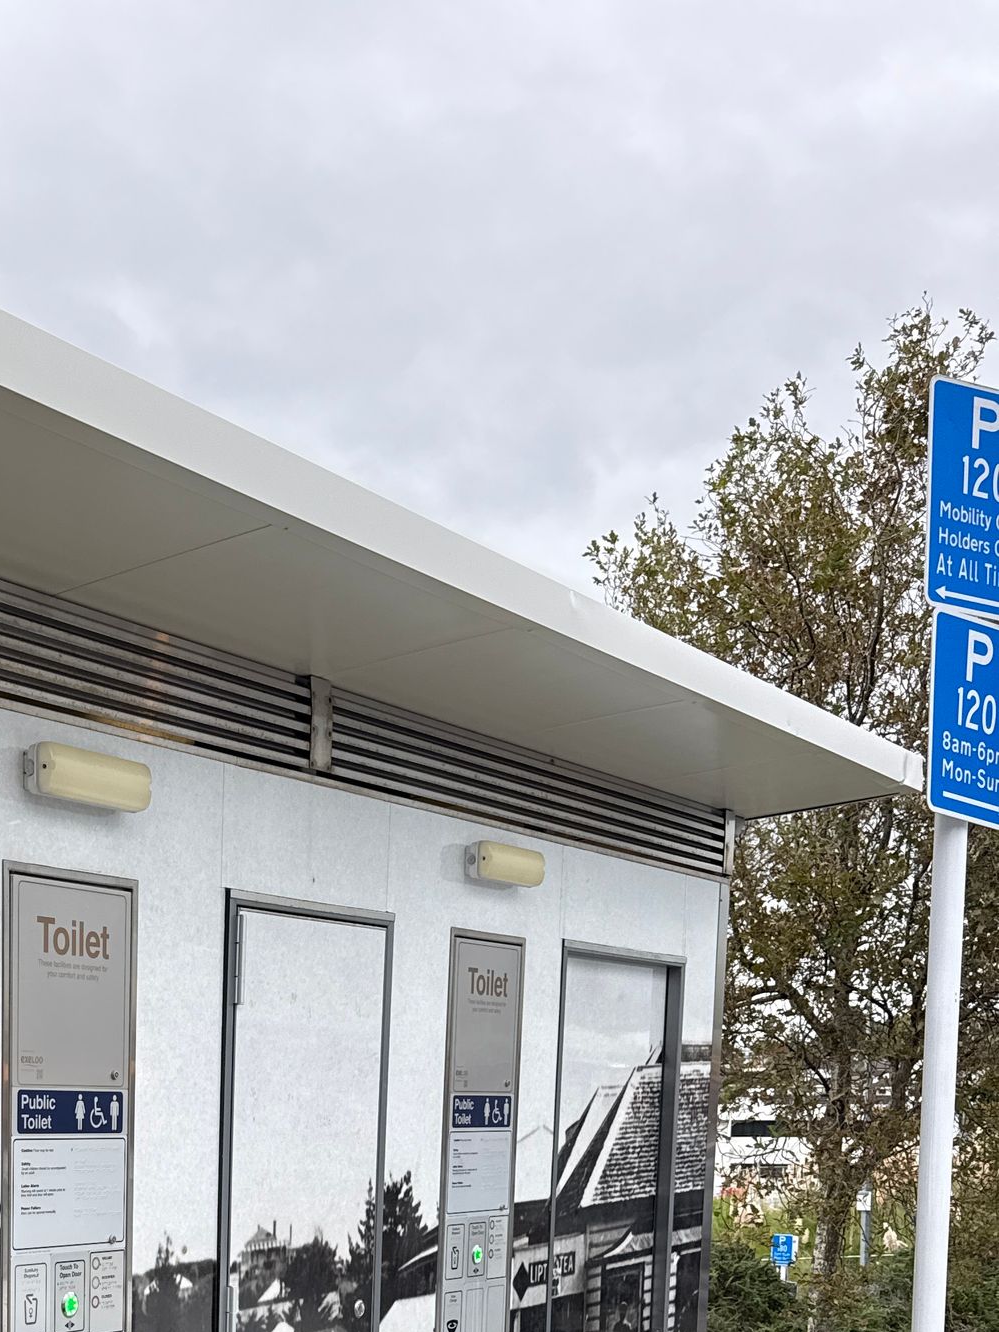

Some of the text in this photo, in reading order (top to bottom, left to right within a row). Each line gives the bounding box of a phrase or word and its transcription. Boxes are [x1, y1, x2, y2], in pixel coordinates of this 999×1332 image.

[972, 396, 999, 450] P
[939, 500, 992, 532] Mobility
[938, 526, 991, 555] Holders
[936, 552, 999, 588] At All Ti
[965, 628, 994, 683] P
[957, 686, 997, 736] 120
[36, 915, 110, 960] Toilet
[468, 967, 508, 998] Toilet
[21, 1094, 56, 1110] Public
[454, 1098, 475, 1110] Public
[21, 1114, 52, 1130] Toilet
[454, 1113, 472, 1125] Toilet
[559, 1254, 574, 1274] TEA
